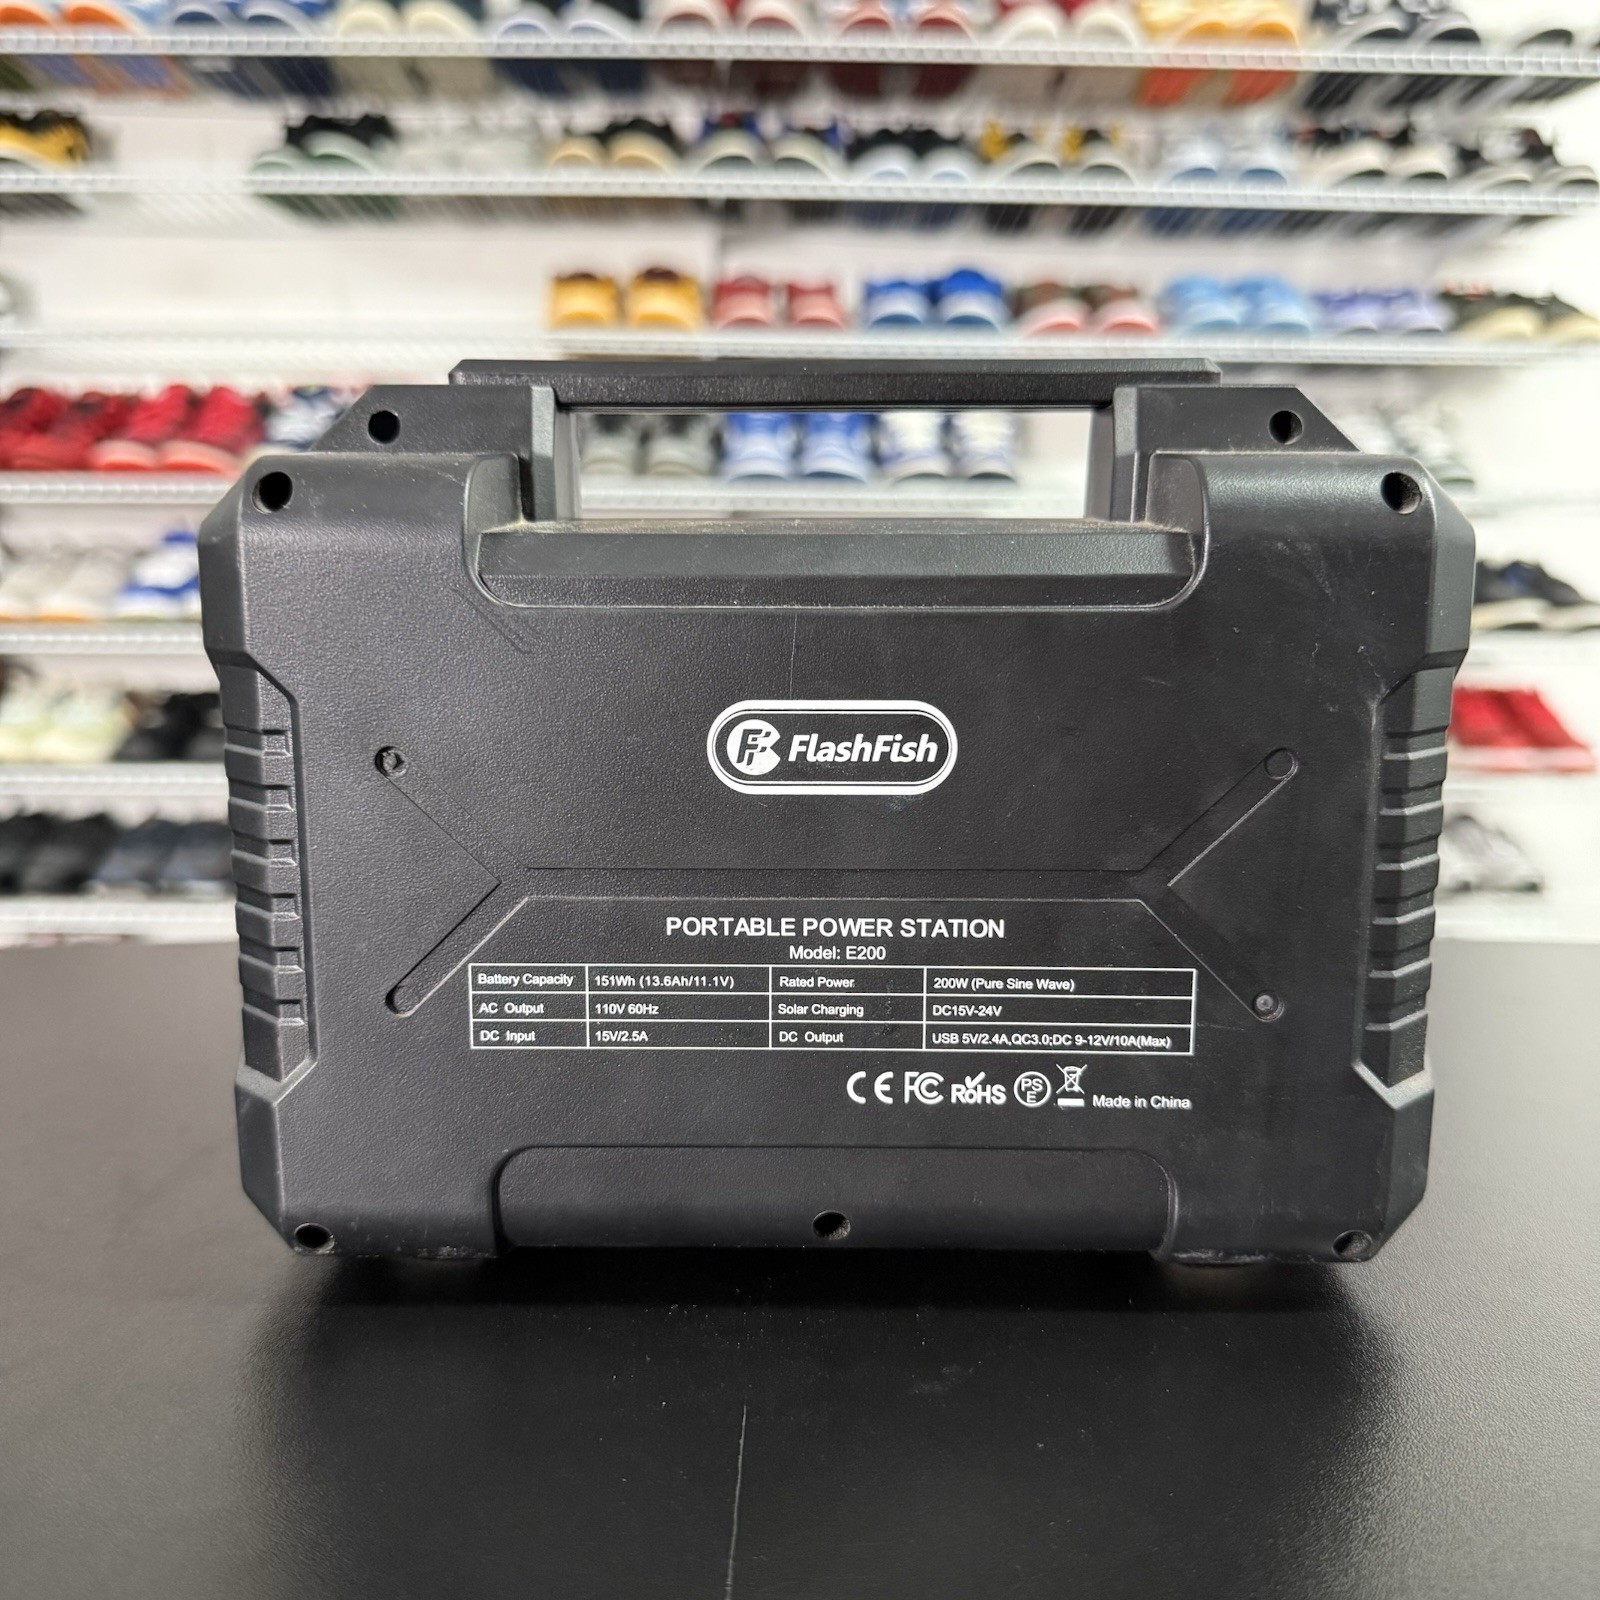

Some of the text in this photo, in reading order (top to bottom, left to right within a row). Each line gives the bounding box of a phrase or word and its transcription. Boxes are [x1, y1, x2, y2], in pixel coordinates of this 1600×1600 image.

[788, 733, 938, 762] FlashFish
[666, 917, 1004, 938] PORTABLE POWER STATION
[790, 945, 886, 960] Model: E200
[477, 973, 573, 987] Battery Capacity
[594, 975, 734, 989] 151Wh (13.6Ah/11.1V)
[780, 976, 855, 988] Rated Power
[933, 977, 1075, 992] 200W (Pure Sine Wave)
[479, 1002, 544, 1016] AC Output
[595, 1003, 659, 1015] 110V 60Hz
[778, 1004, 864, 1018] Solar Charging
[933, 1005, 1002, 1016] DC15V-24V
[479, 1030, 536, 1044] DC Input
[595, 1031, 648, 1042] 15V/2.5A
[779, 1031, 843, 1045] DC Output
[932, 1033, 959, 1044] USB
[1093, 1095, 1191, 1109] Made in China
